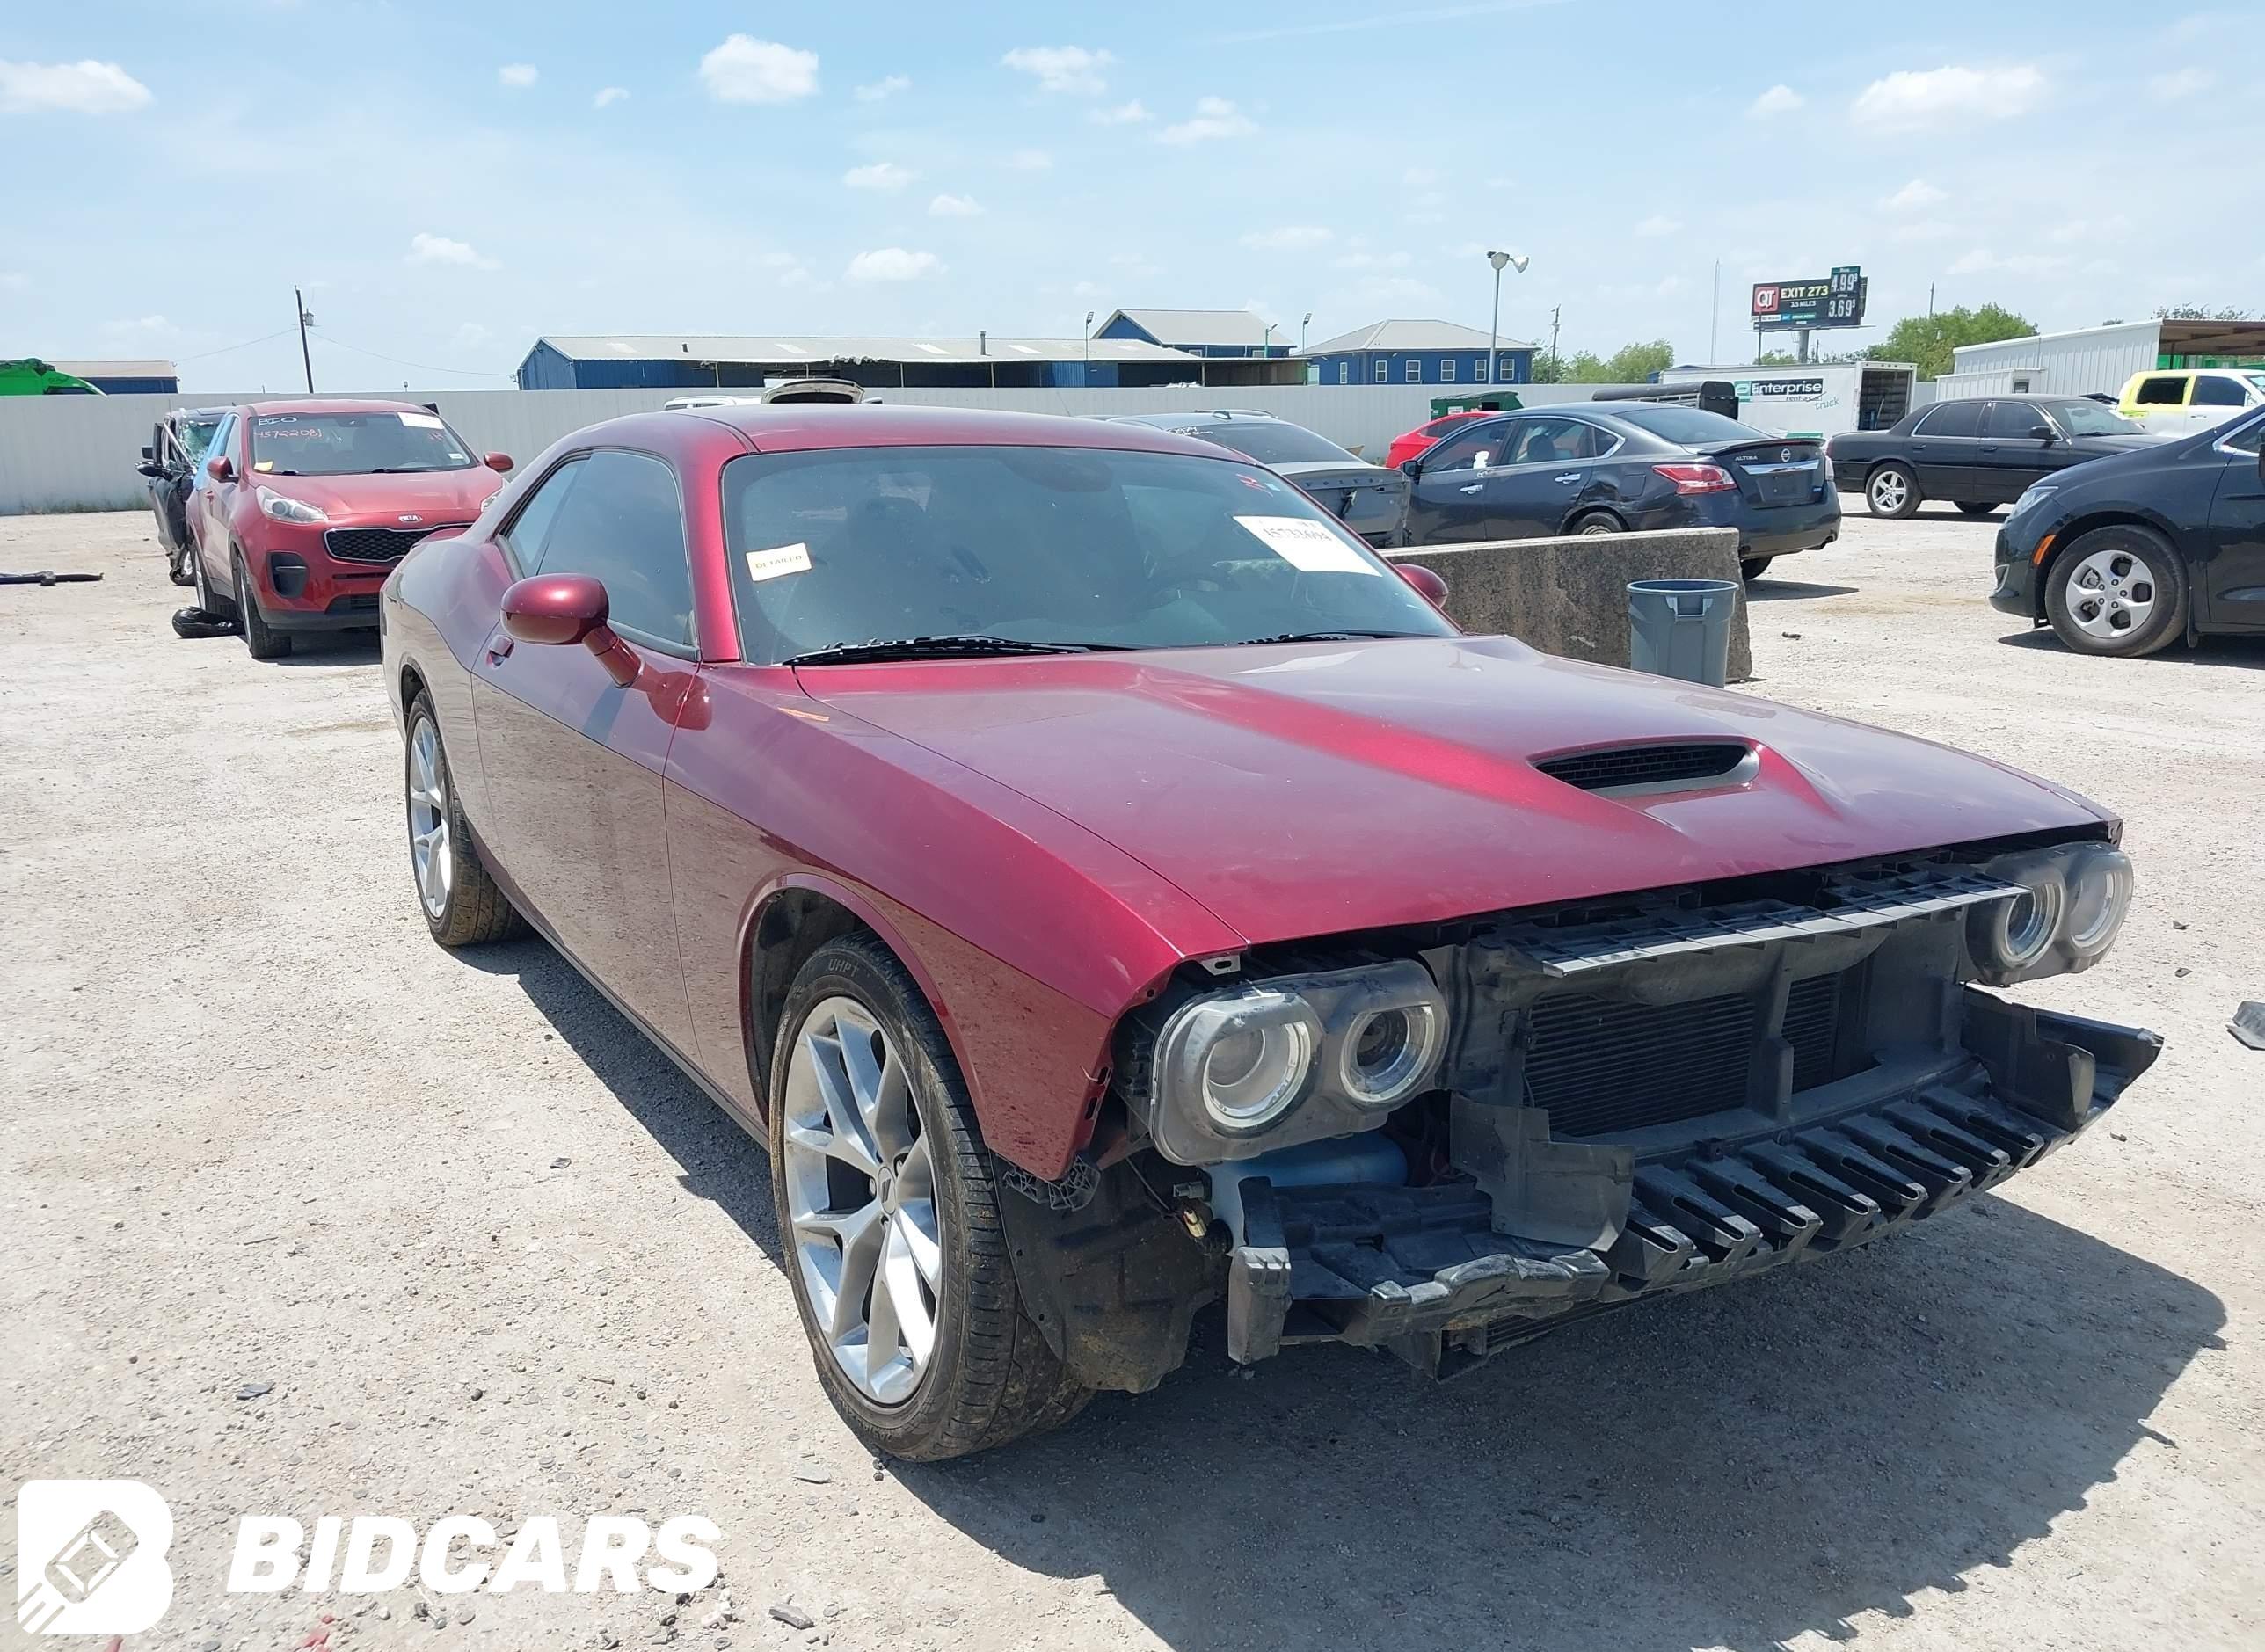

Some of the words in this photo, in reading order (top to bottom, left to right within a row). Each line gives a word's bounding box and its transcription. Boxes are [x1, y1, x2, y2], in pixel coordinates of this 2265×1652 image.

[1757, 290, 1775, 308] QT
[1781, 287, 1806, 299] EXIT
[1808, 286, 1829, 297] 273
[1751, 380, 1823, 396] Enterprise
[1814, 397, 1839, 411] truck
